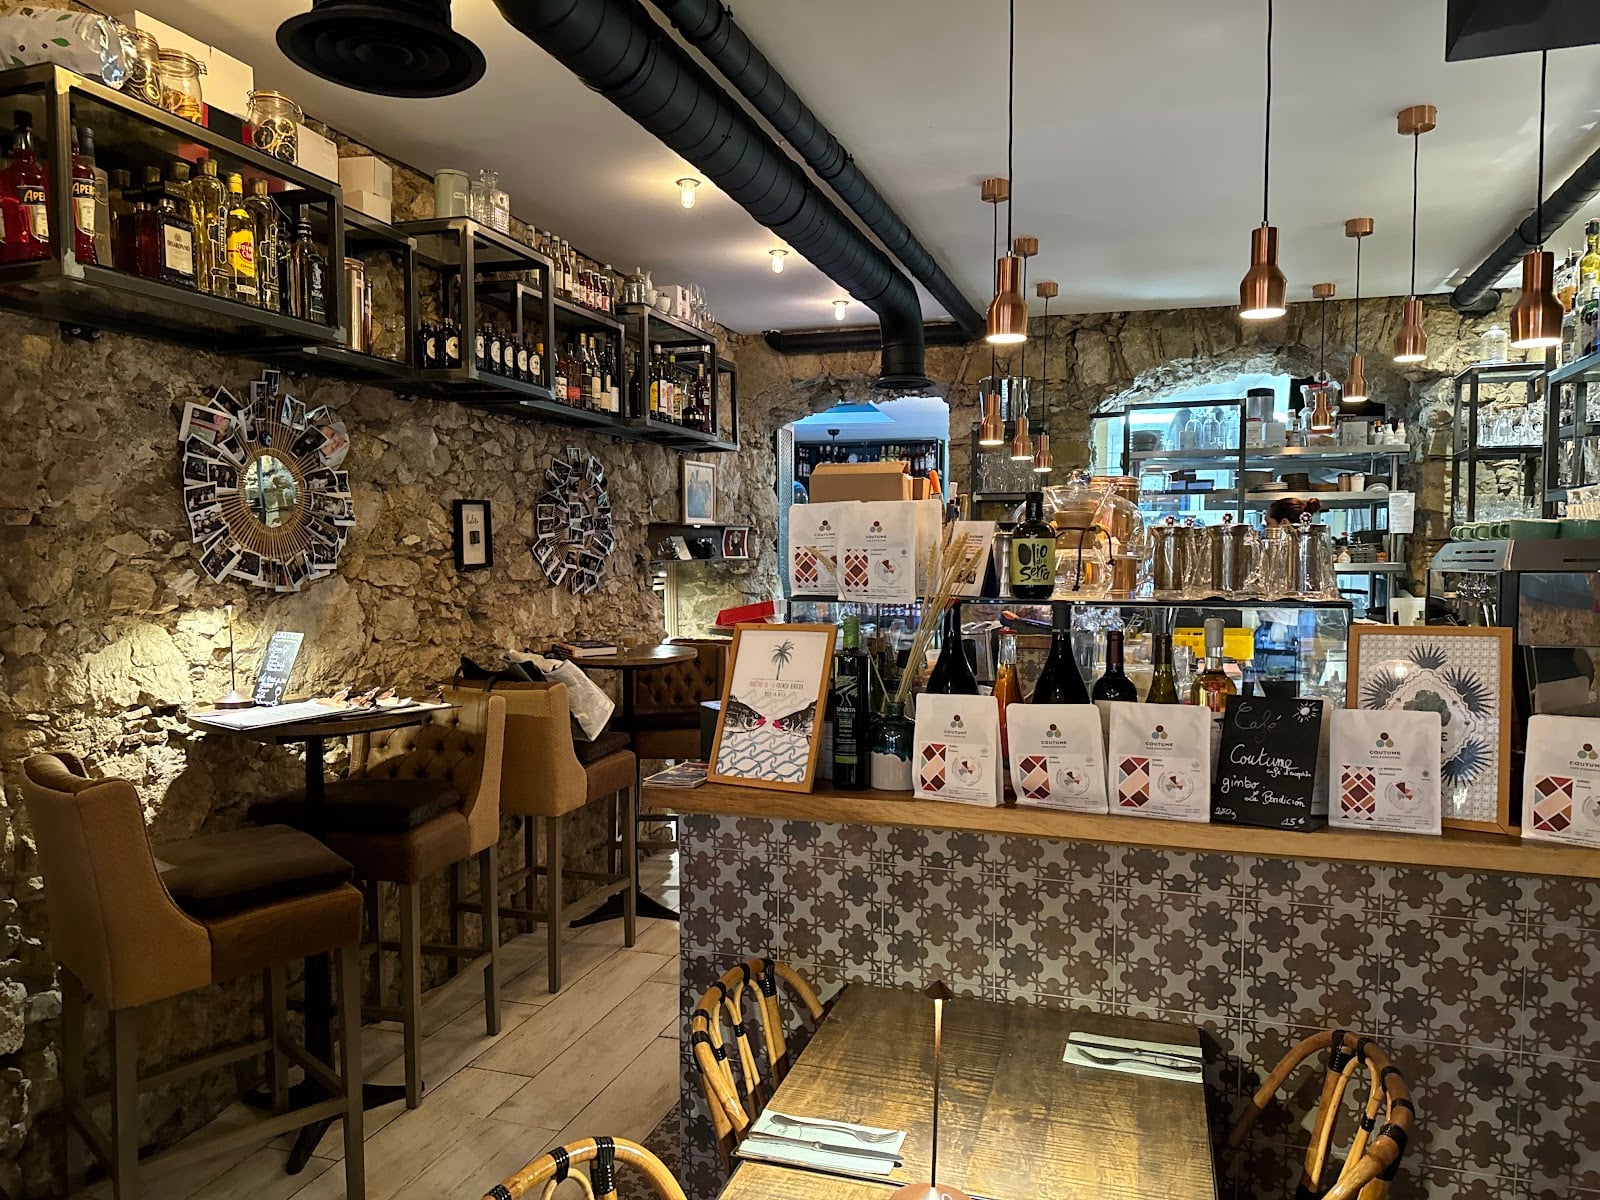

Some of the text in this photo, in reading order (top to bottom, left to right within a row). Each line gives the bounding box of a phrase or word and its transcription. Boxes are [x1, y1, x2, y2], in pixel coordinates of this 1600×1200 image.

[1018, 543, 1047, 566] Olio
[1019, 564, 1050, 582] Serra
[1234, 702, 1282, 743] Café
[1230, 744, 1299, 770] Coutume
